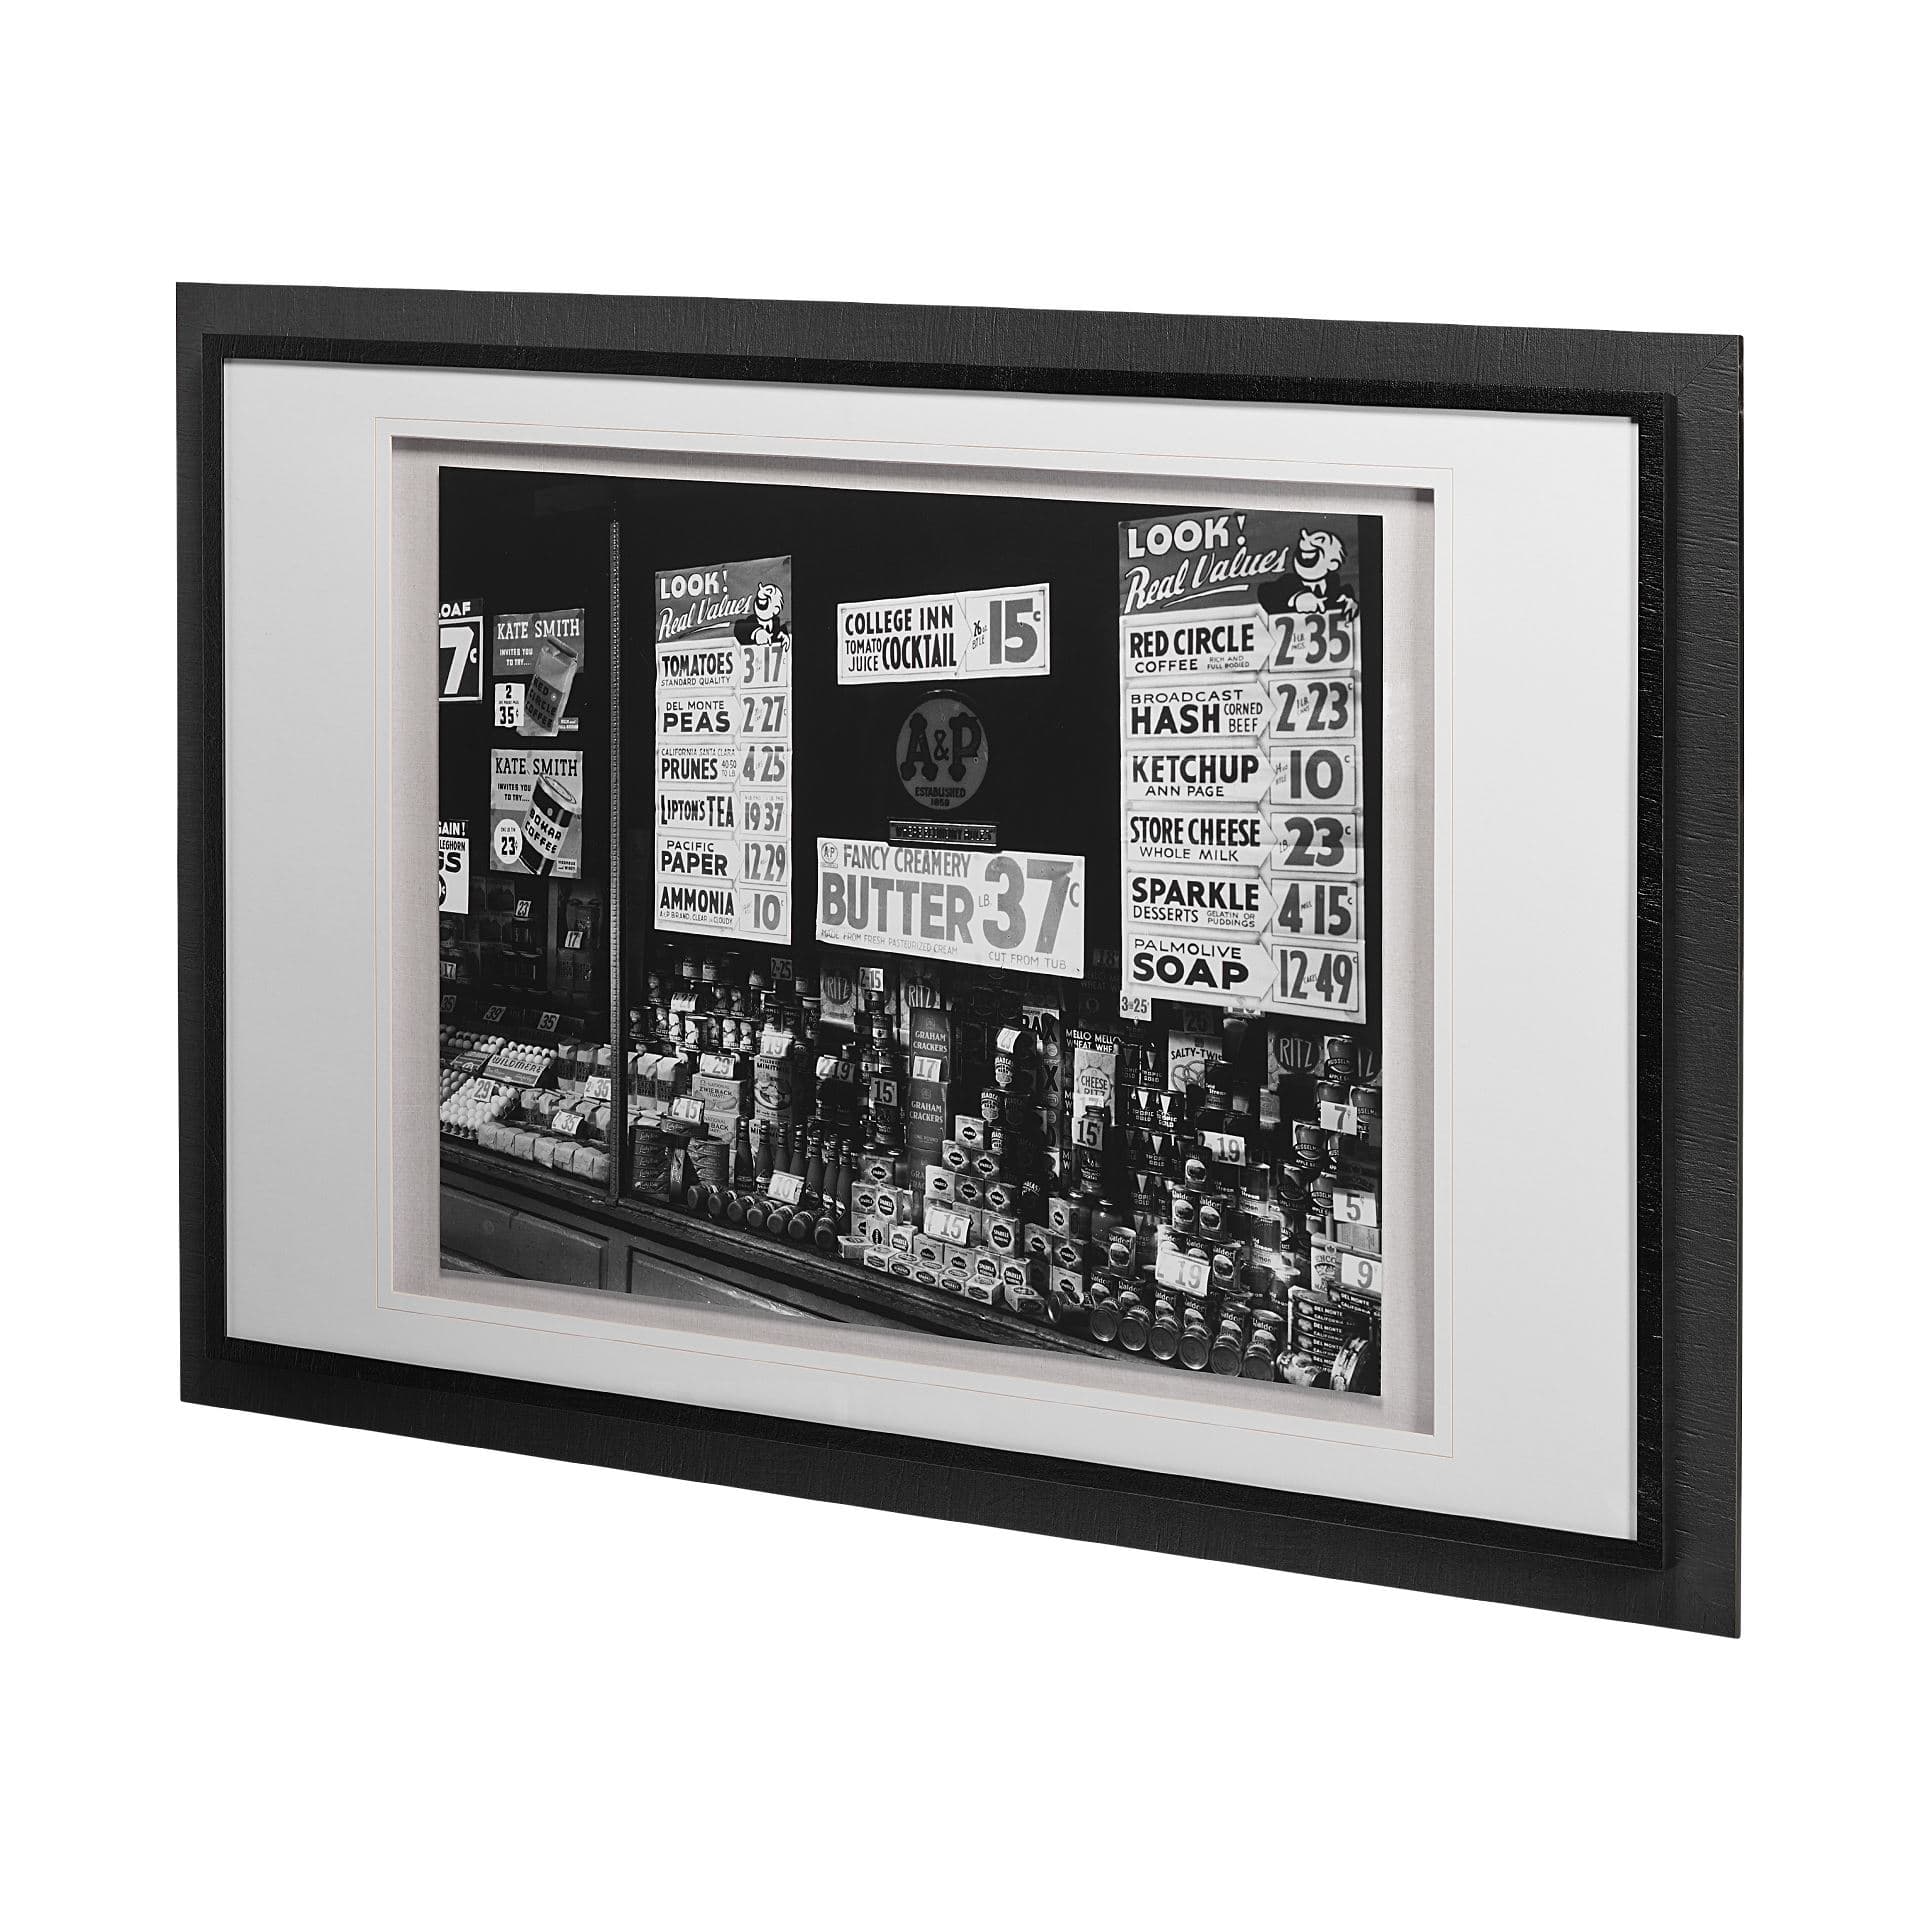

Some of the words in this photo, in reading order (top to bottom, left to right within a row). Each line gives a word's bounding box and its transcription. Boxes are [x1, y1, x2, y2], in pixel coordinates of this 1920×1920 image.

[1128, 515, 1246, 559] LOOK!
[660, 569, 728, 600] LOOK!
[1124, 559, 1189, 614] Real
[1192, 546, 1289, 589] Values
[438, 601, 471, 618] OAF
[658, 603, 697, 641] Real
[697, 594, 752, 625] Values
[845, 608, 912, 636] COLLEGE
[920, 604, 953, 631] INN
[497, 622, 528, 640] KATE
[534, 618, 580, 638] SMITH
[845, 637, 882, 655] TOMATO
[882, 632, 957, 671] COCKTAIL
[1130, 629, 1169, 658] RED
[1174, 623, 1254, 655] CIRCLE
[1275, 616, 1294, 666] 2
[661, 652, 734, 677] TOMATOES
[848, 656, 879, 672] JUICE
[1135, 659, 1198, 674] COFFEE
[505, 685, 512, 699] 2
[661, 678, 697, 687] STANDARD
[699, 676, 731, 685] QUALITY
[666, 701, 684, 711] DEL
[687, 700, 725, 710] MONTE
[1131, 689, 1243, 705] BROADCAST
[1276, 683, 1297, 732] 2
[663, 711, 731, 733] PEAS
[1131, 703, 1220, 735] HASH
[1224, 702, 1263, 716] CORNED
[1229, 717, 1258, 733] BEEF
[900, 712, 982, 782] A&P
[495, 757, 527, 775] KATE
[533, 758, 578, 777] SMITH
[661, 758, 718, 780] PRUNES
[1132, 754, 1260, 784] KETCHUP
[1145, 785, 1180, 797] ANN
[1187, 786, 1225, 797] PAGE
[706, 795, 735, 828] TEA
[744, 802, 760, 830] 19
[1130, 816, 1184, 845] STORE
[1188, 818, 1261, 847] CHEESE
[440, 839, 466, 851] LEGHORN
[667, 840, 714, 852] PACIFIC
[1140, 846, 1190, 860] WHOLE
[1199, 849, 1239, 862] MILK
[661, 850, 728, 877] PAPER
[843, 843, 890, 871] FANCY
[894, 848, 971, 879] CREAMERY
[660, 886, 735, 916] AMMONIA
[978, 893, 990, 909] LB
[1131, 876, 1260, 912] SPARKLE
[822, 871, 974, 945] BUTTER
[1133, 905, 1199, 923] DESSERTS
[1206, 910, 1239, 919] GELATIN
[1243, 912, 1256, 920] OR
[1278, 882, 1303, 933] 4
[1207, 918, 1256, 928] PUDDINGS
[864, 935, 885, 945] FRESH
[888, 938, 932, 952] PASTEURIZED
[933, 944, 958, 955] CREAM
[1134, 939, 1241, 960] PALMOLIVE
[988, 951, 1007, 962] CUT
[1010, 952, 1040, 966] FROM
[1044, 957, 1067, 970] TUB
[1133, 952, 1249, 990] SOAP
[1280, 949, 1308, 1000] 12
[827, 976, 849, 1000] RITZ
[908, 985, 932, 1008] RITZ
[915, 1030, 946, 1042] GRAHAM
[1065, 1028, 1092, 1041] MELLO
[913, 1041, 948, 1053] CRACKERS
[1279, 1037, 1312, 1069] RITZ
[492, 1055, 544, 1074] WILDMERE
[916, 1058, 938, 1079] 17
[475, 1080, 491, 1099] 29
[699, 1086, 733, 1097] ZWIEBACK
[873, 1080, 894, 1103] 15
[1081, 1075, 1108, 1090] CHEESE
[909, 1110, 944, 1124] CRACKERS
[911, 1100, 942, 1113] GRAHAM
[1077, 1119, 1098, 1147] 15
[1217, 1136, 1241, 1163] 19
[1174, 1259, 1202, 1289] 19
